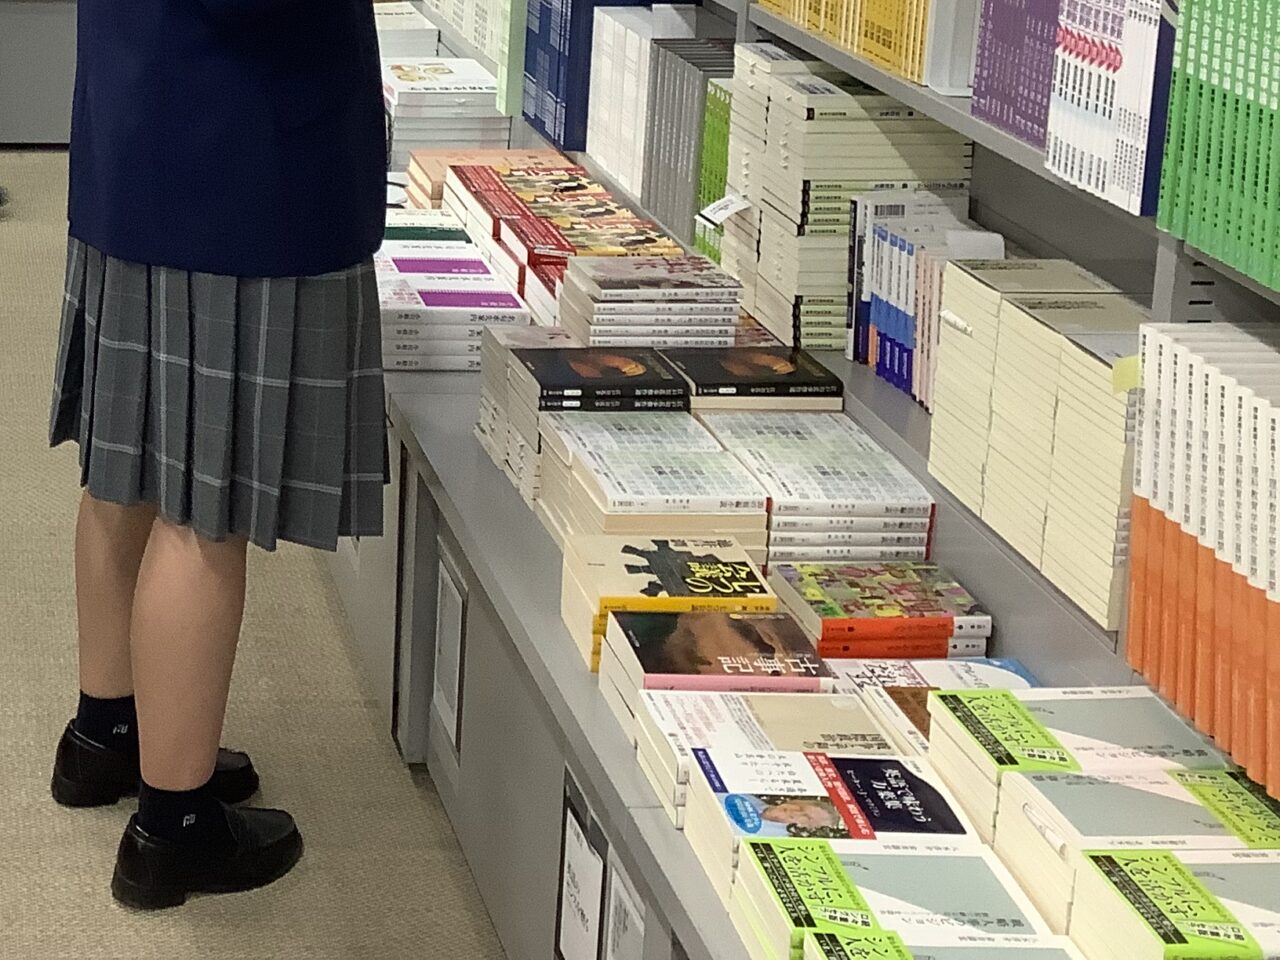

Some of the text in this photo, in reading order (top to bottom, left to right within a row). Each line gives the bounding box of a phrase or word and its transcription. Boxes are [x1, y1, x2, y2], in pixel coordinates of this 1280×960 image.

[683, 577, 761, 596] 七つの
[717, 656, 820, 676] 古事記
